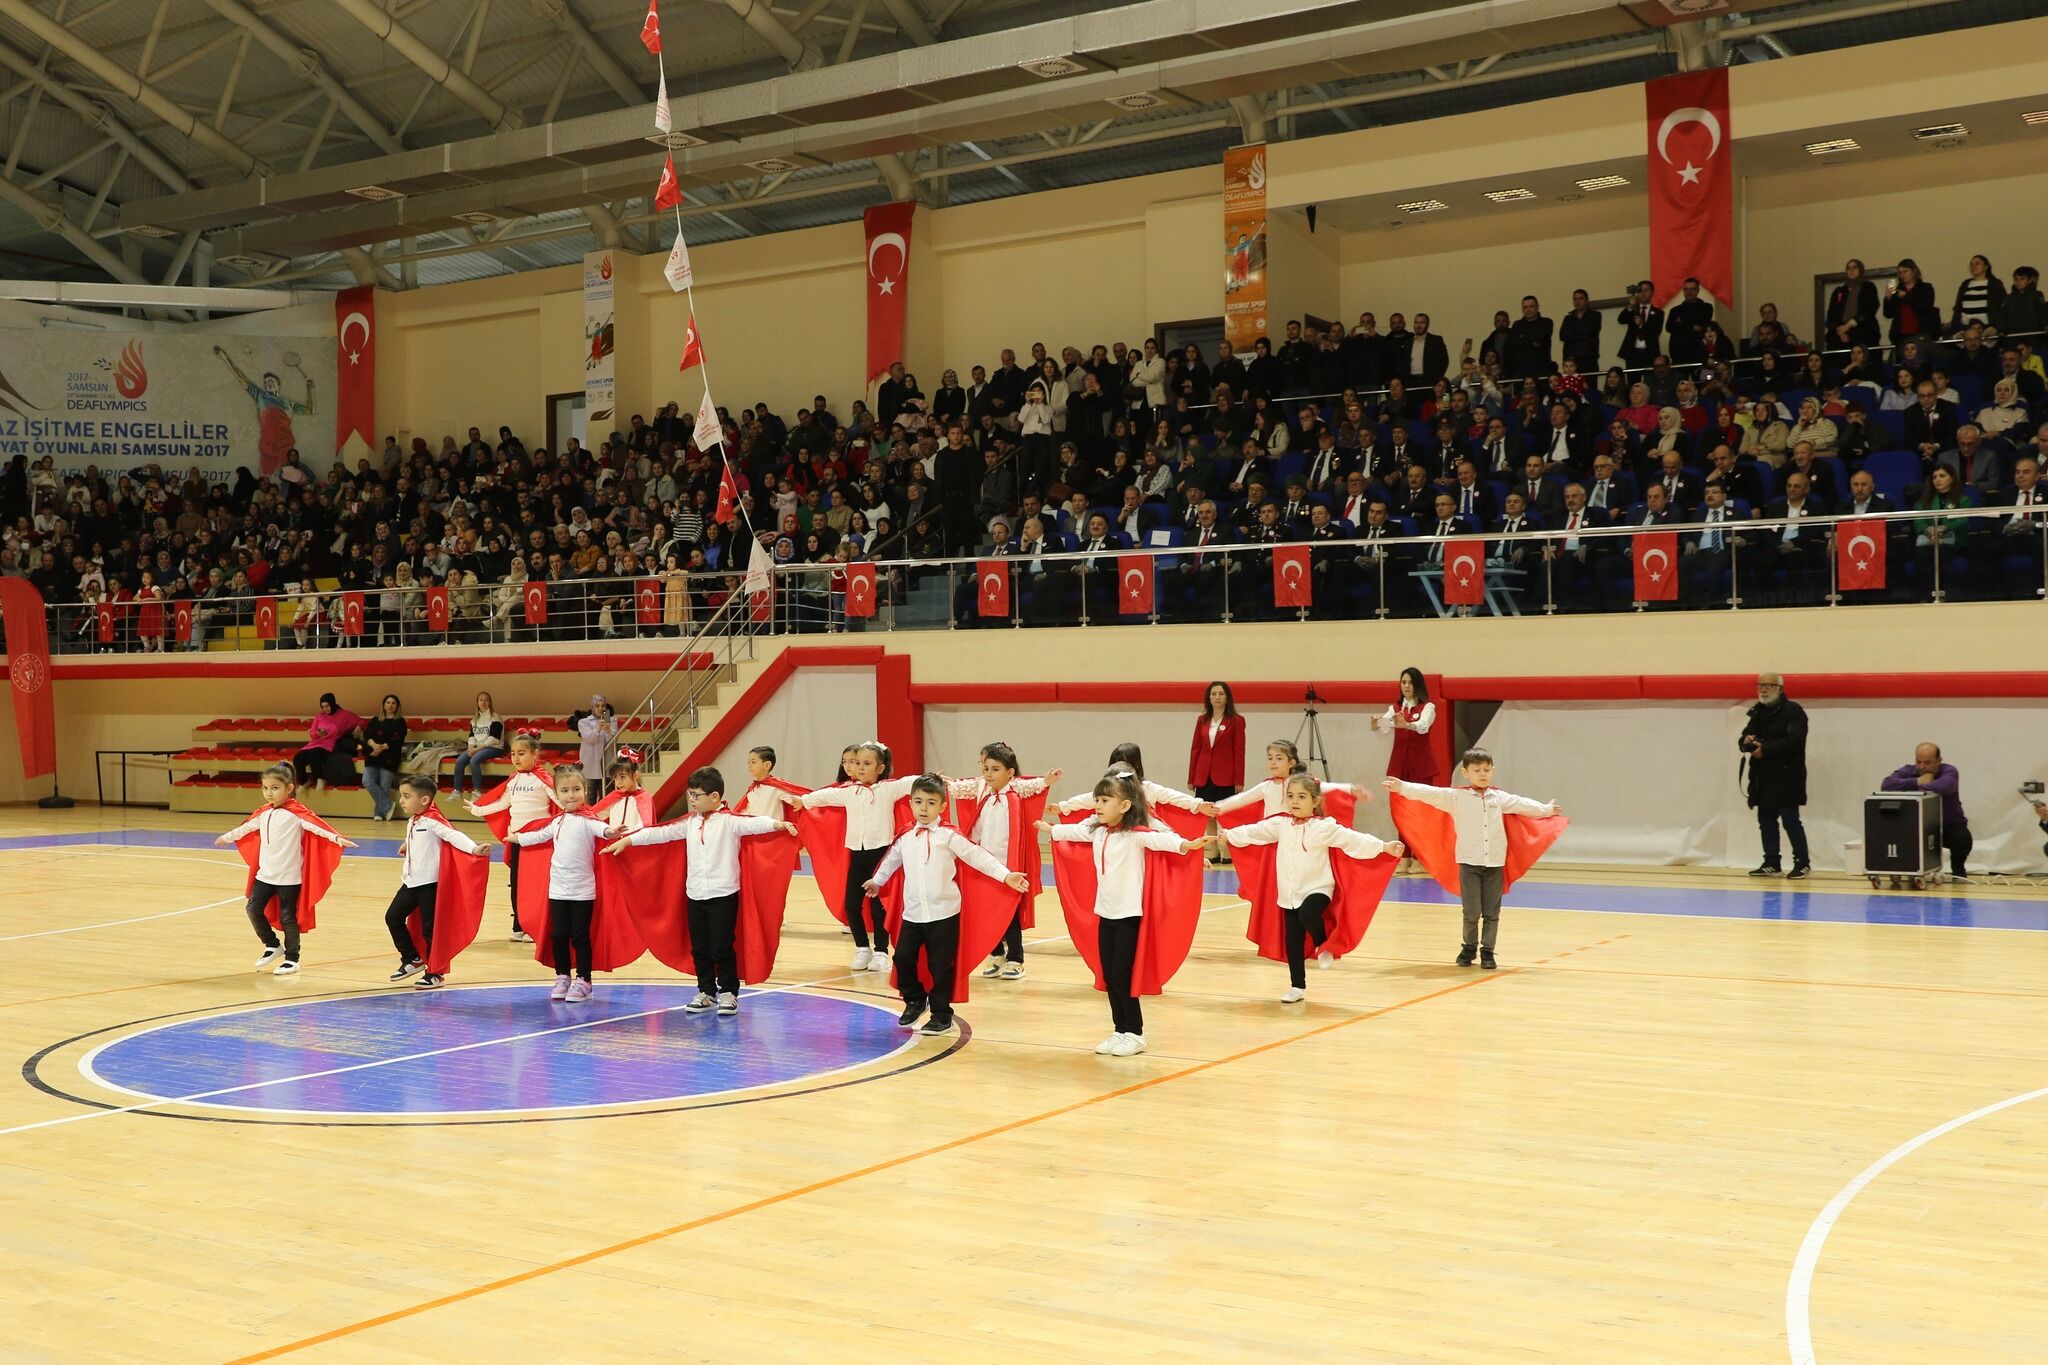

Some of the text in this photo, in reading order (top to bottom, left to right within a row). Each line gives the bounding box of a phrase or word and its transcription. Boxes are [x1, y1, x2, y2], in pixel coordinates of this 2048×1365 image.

[67, 373, 88, 381] 2017
[66, 382, 109, 392] SAMSUN
[67, 399, 148, 412] DEAFLYMPICS
[0, 417, 229, 440] Z İŞİTME ENGELLİLER
[33, 441, 118, 455] OYUNLARI
[121, 443, 191, 457] SAMSUN
[194, 444, 230, 457] 2017
[200, 470, 231, 482] 2017
